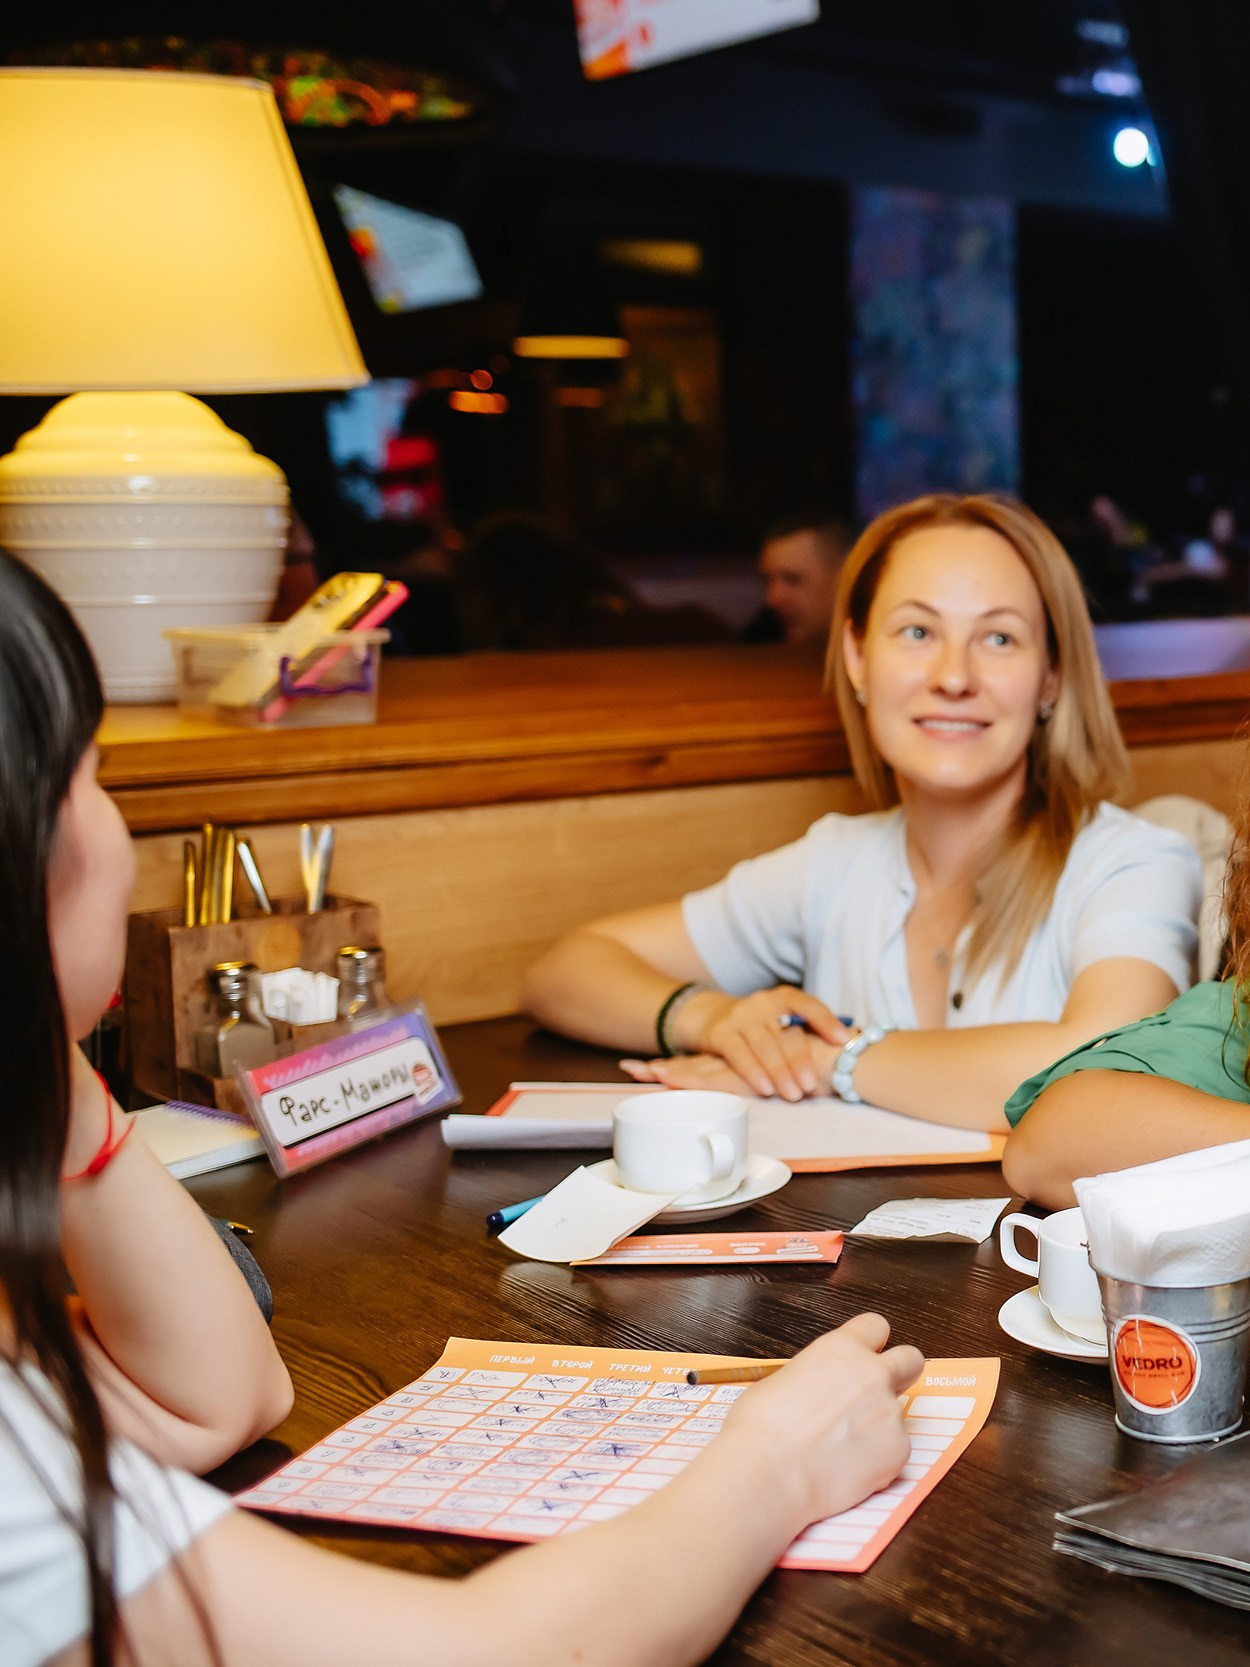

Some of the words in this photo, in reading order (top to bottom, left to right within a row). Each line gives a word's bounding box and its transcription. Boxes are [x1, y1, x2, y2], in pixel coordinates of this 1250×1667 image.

[489, 1354, 536, 1365] ПЕРВЫЙ
[551, 1358, 594, 1370] ВТОРОЙ
[608, 1362, 653, 1374] ТРЕТИЙ
[662, 1366, 697, 1376] ЧЕТВ
[925, 1374, 977, 1387] ВОСЬМОЙ
[1122, 1354, 1183, 1370] VEDRO
